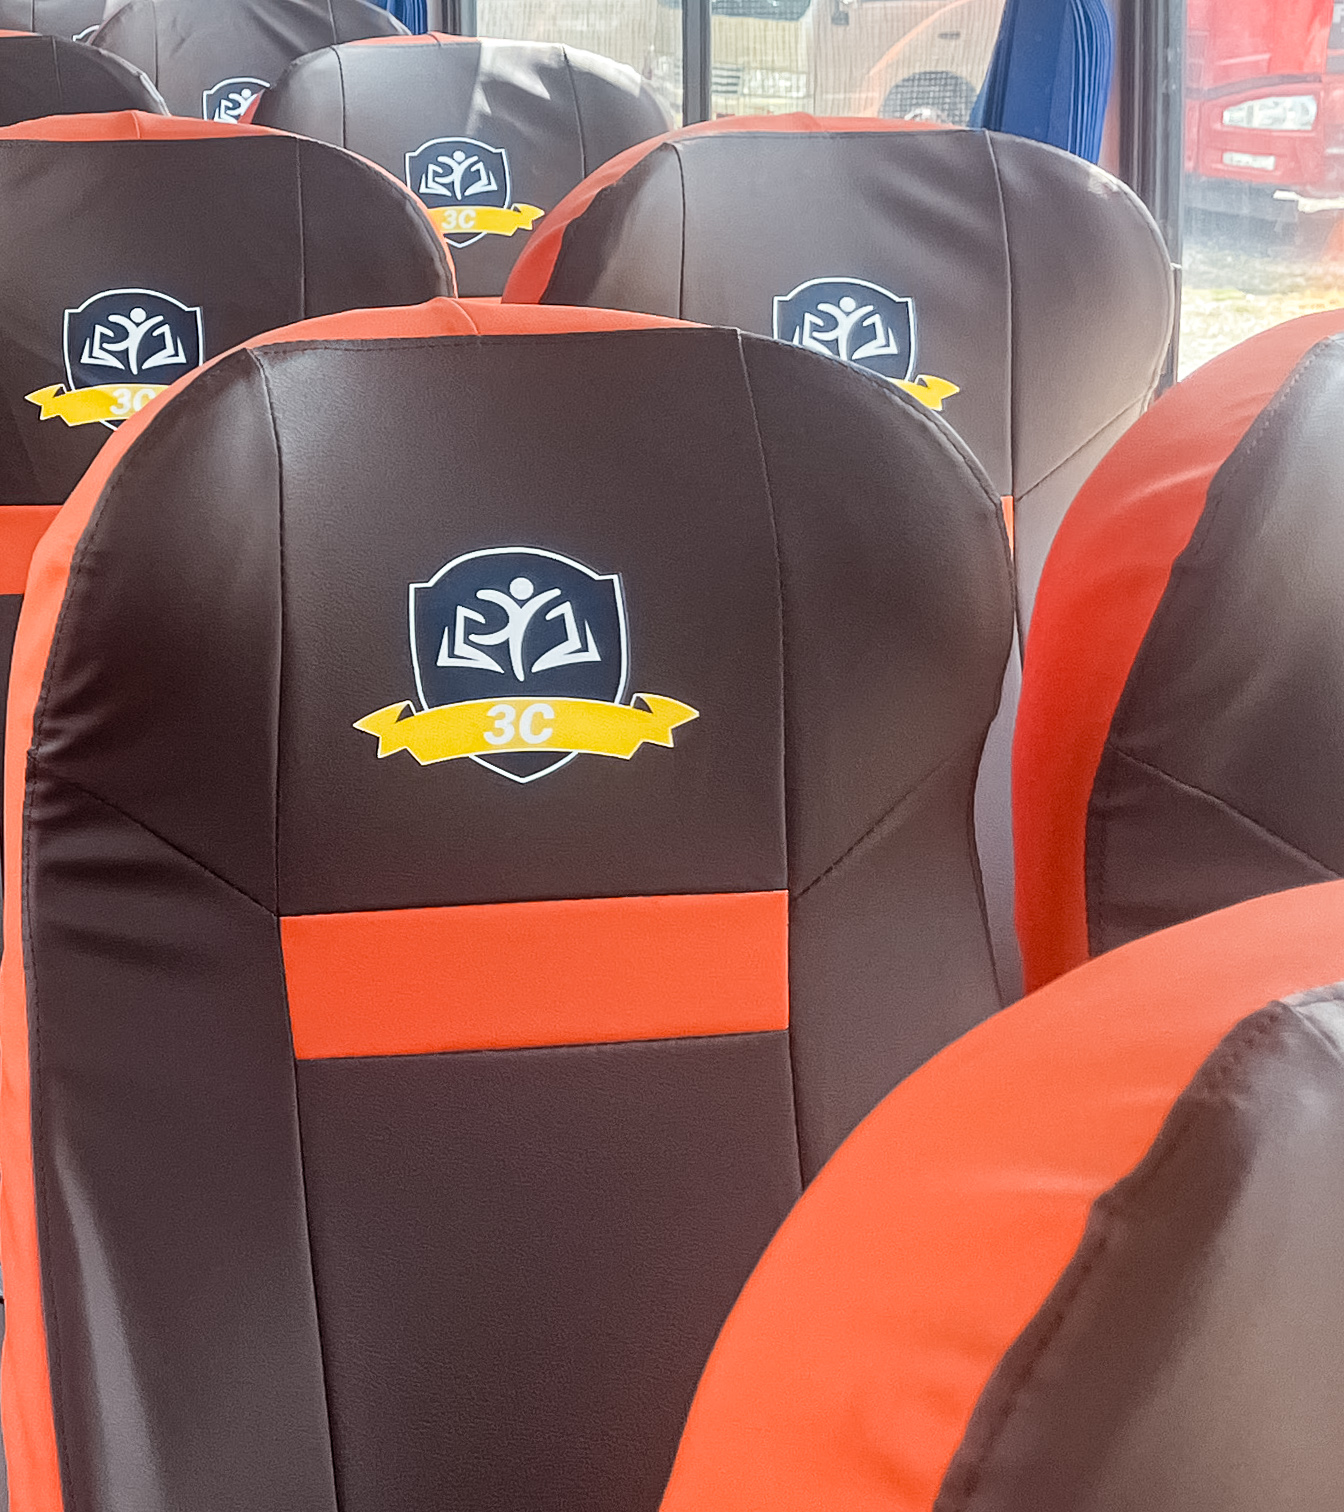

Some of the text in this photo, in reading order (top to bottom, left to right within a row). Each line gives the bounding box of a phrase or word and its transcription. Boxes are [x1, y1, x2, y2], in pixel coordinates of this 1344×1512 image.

[441, 208, 477, 230] 3C
[109, 387, 157, 416] 3C
[483, 702, 555, 746] 3C
